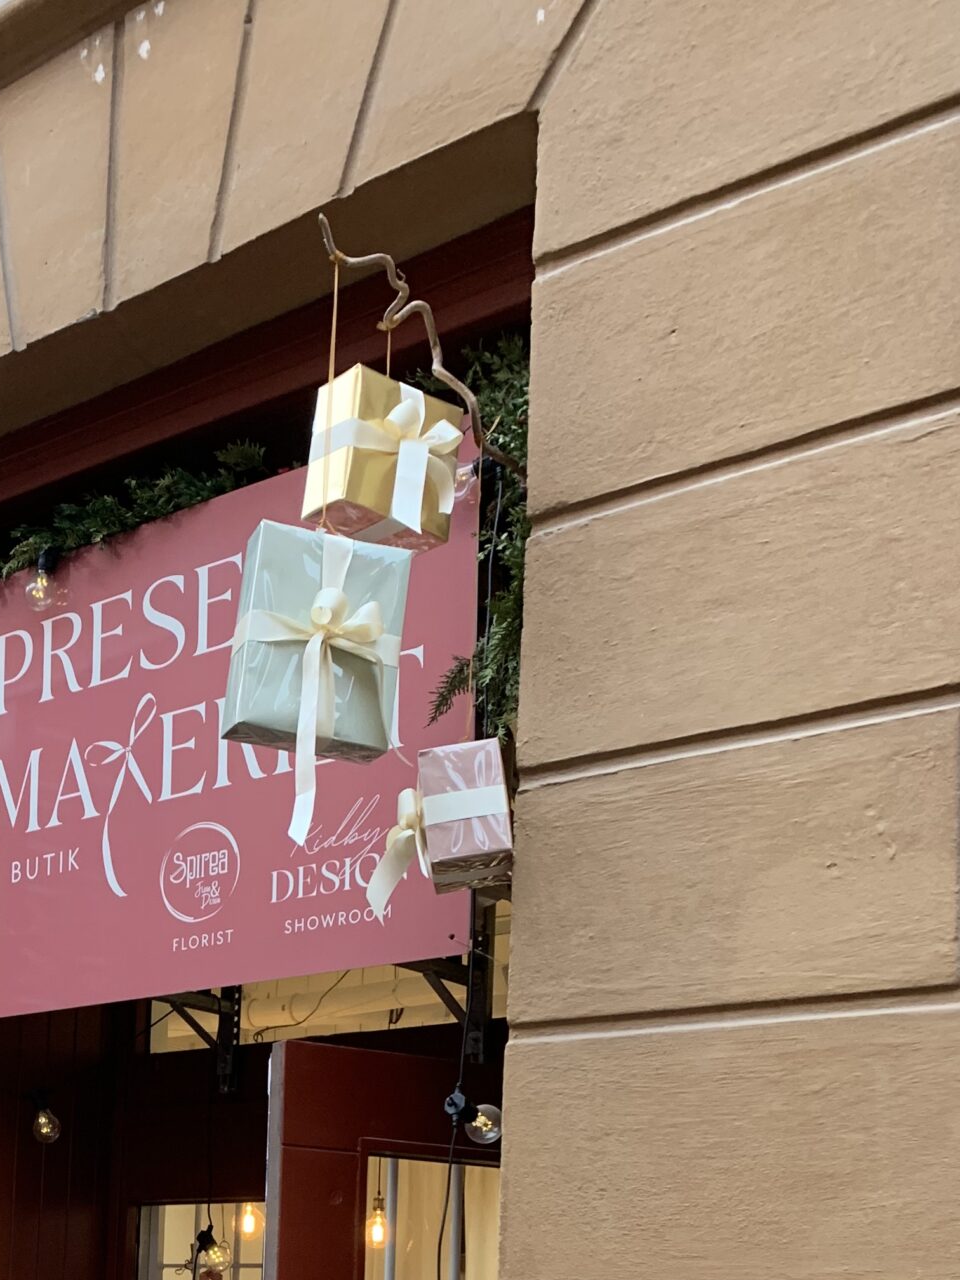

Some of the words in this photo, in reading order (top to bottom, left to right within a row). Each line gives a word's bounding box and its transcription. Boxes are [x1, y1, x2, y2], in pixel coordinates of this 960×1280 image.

[11, 847, 80, 883] BUTIK
[170, 849, 228, 888] Spirea
[270, 853, 408, 904] DESIG
[172, 929, 234, 952] FLORIST
